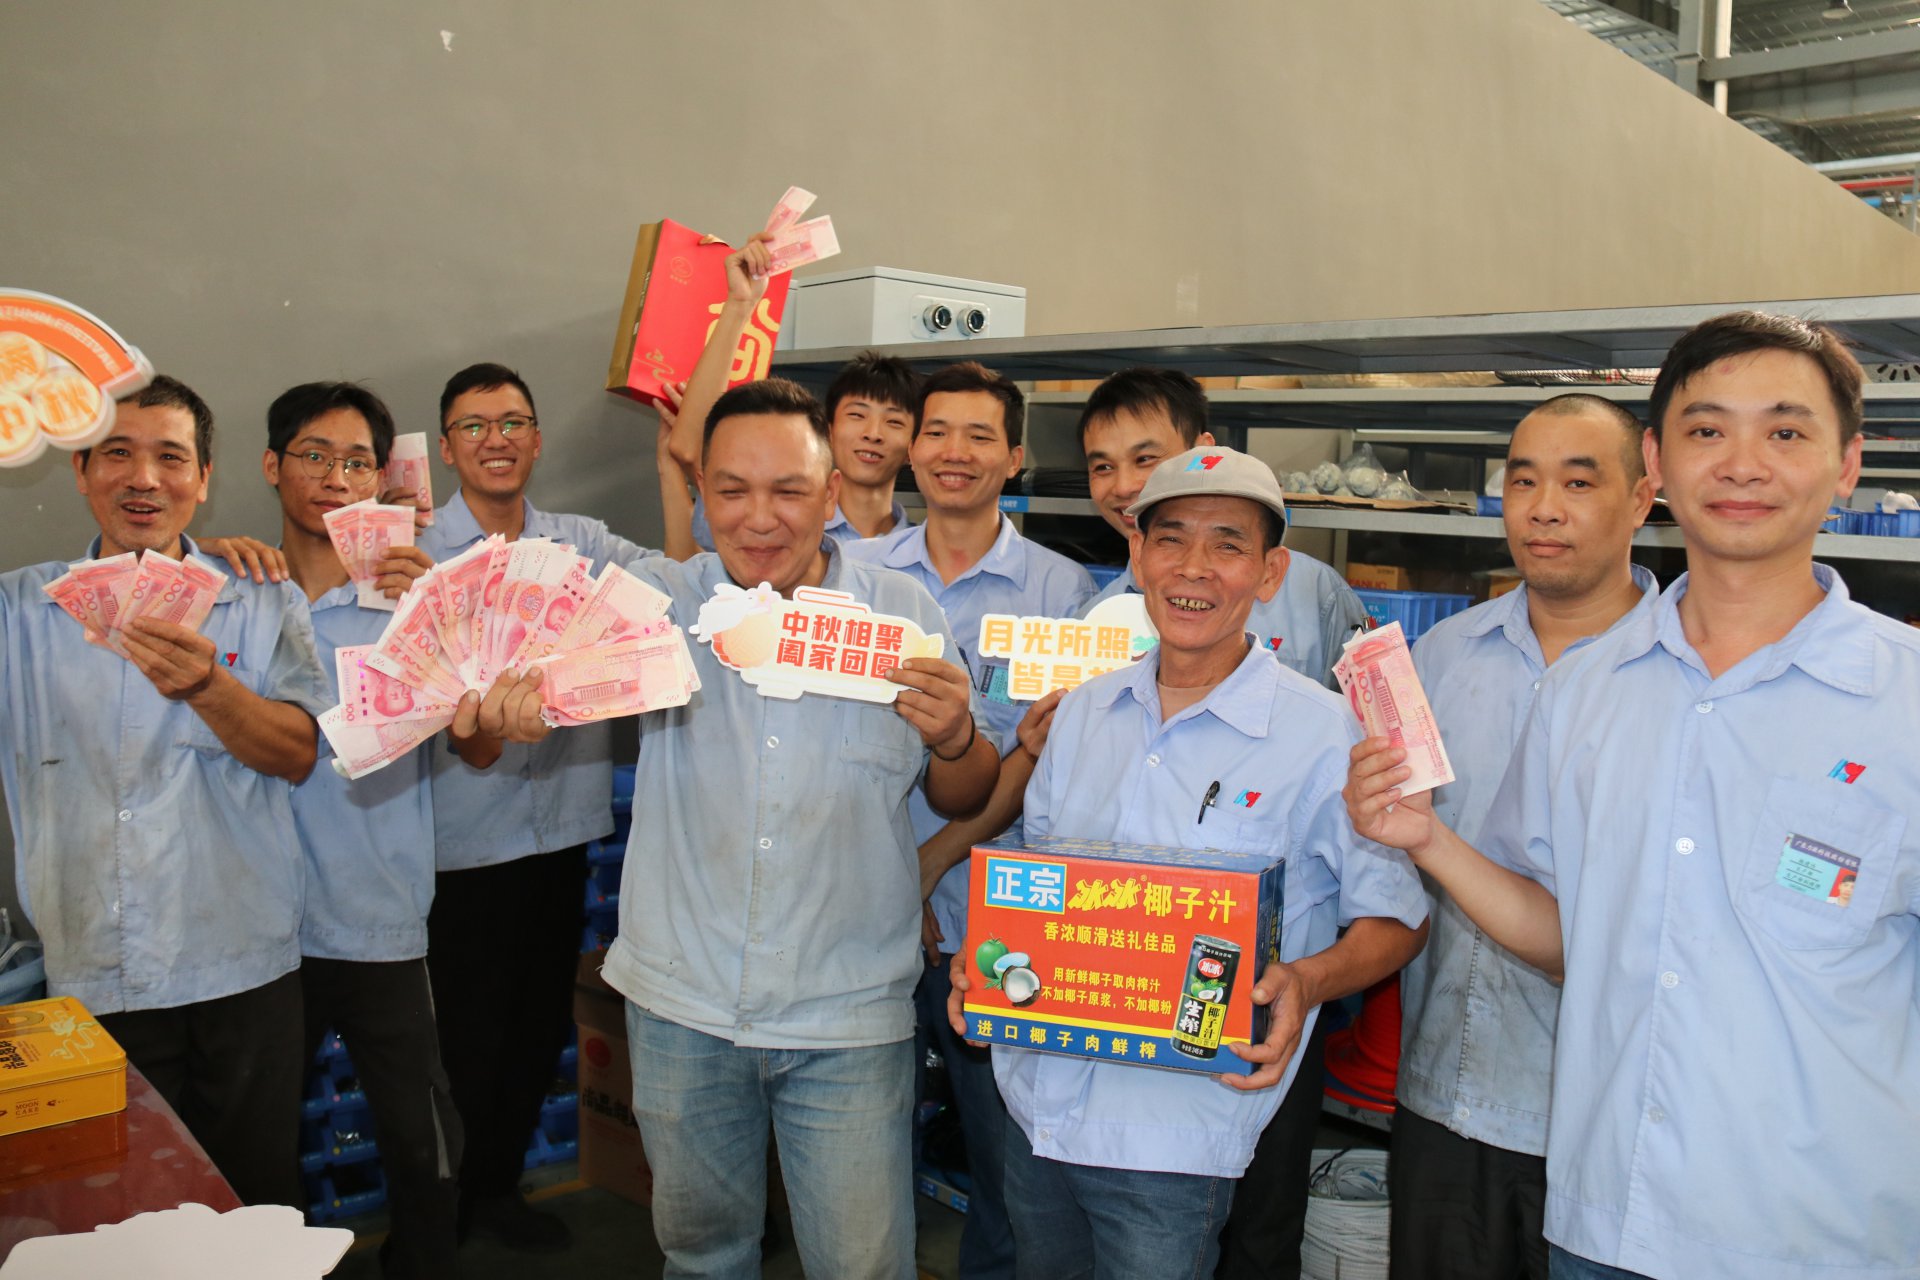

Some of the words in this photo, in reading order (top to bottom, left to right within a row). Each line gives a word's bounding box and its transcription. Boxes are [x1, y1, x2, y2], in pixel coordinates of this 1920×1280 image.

[80, 587, 98, 612] 100
[132, 575, 149, 600] 100
[164, 577, 185, 603] 100
[451, 590, 466, 616] 100
[414, 631, 437, 657] 100
[782, 610, 905, 652] 中秋相聚
[984, 619, 1130, 660] 月光所照
[776, 638, 900, 679] 阖家团圆
[1012, 662, 1114, 695] 皆是
[1356, 671, 1373, 704] 100
[346, 703, 355, 721] 100
[991, 865, 1061, 907] 正宗
[1067, 878, 1142, 912] 冰冰
[1143, 882, 1237, 924] 椰子汁
[1044, 921, 1176, 954] 香浓顺滑送礼佳品
[1053, 967, 1161, 993] 用新鲜椰子取肉榨汁
[1179, 1000, 1203, 1034] 生榨
[1204, 1006, 1221, 1039] 椰子汁
[977, 1019, 1157, 1060] 进口椰子肉鲜榨
